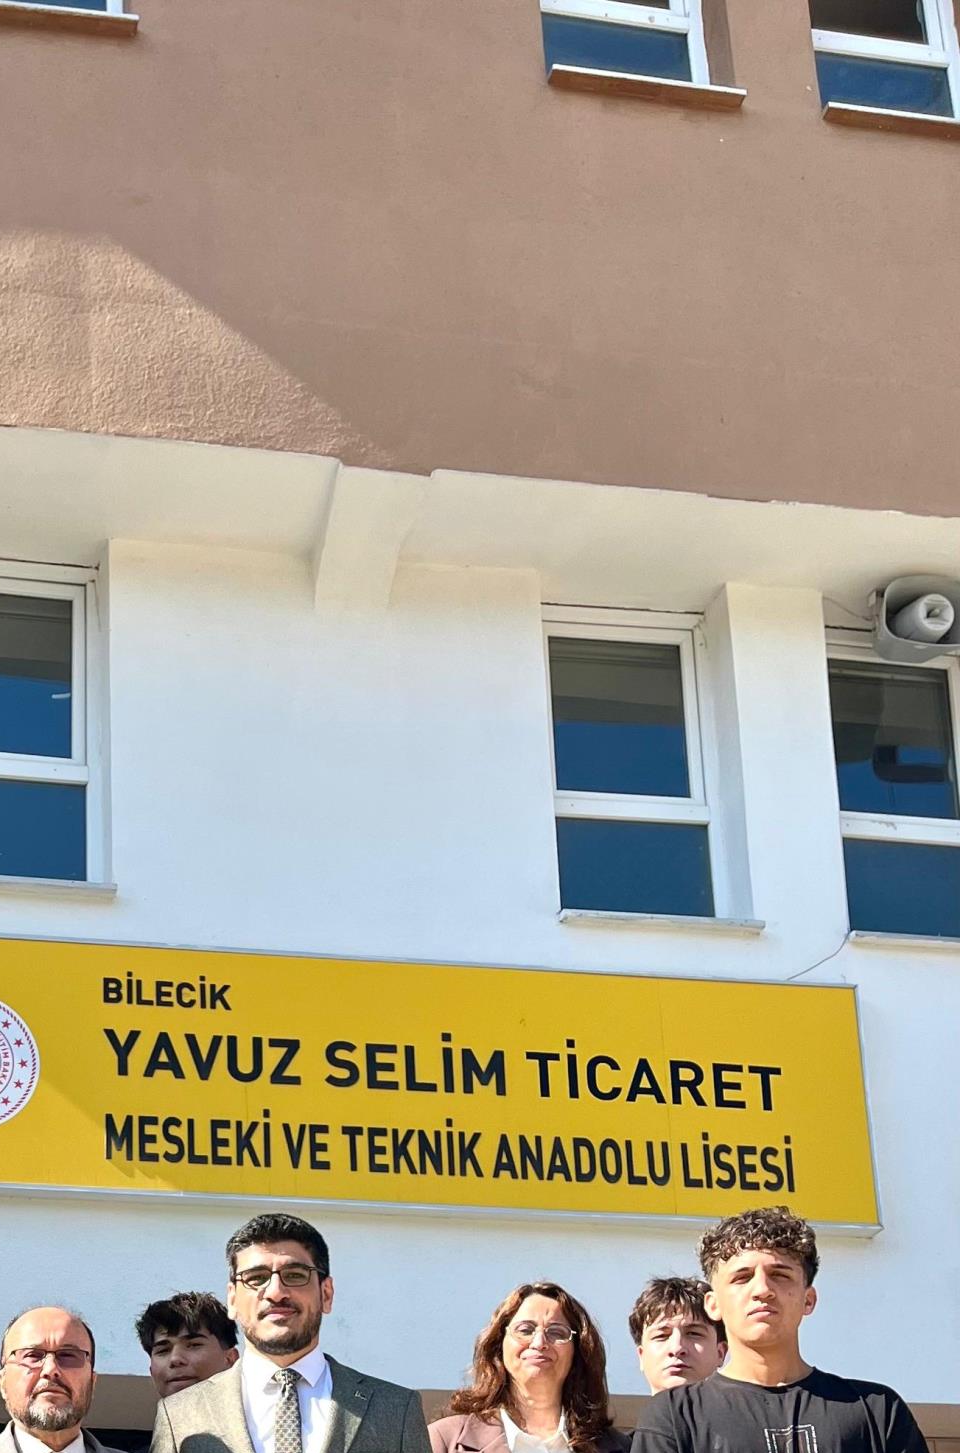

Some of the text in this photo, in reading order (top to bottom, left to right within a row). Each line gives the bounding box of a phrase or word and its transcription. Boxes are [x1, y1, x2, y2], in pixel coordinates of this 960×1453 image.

[103, 971, 232, 1011] BİLECİK
[103, 1028, 782, 1111] YAVUZ SELİM TİCARET
[105, 1108, 796, 1193] MESLEKİ VE TEKNİK ANADOLU LİSESİ
